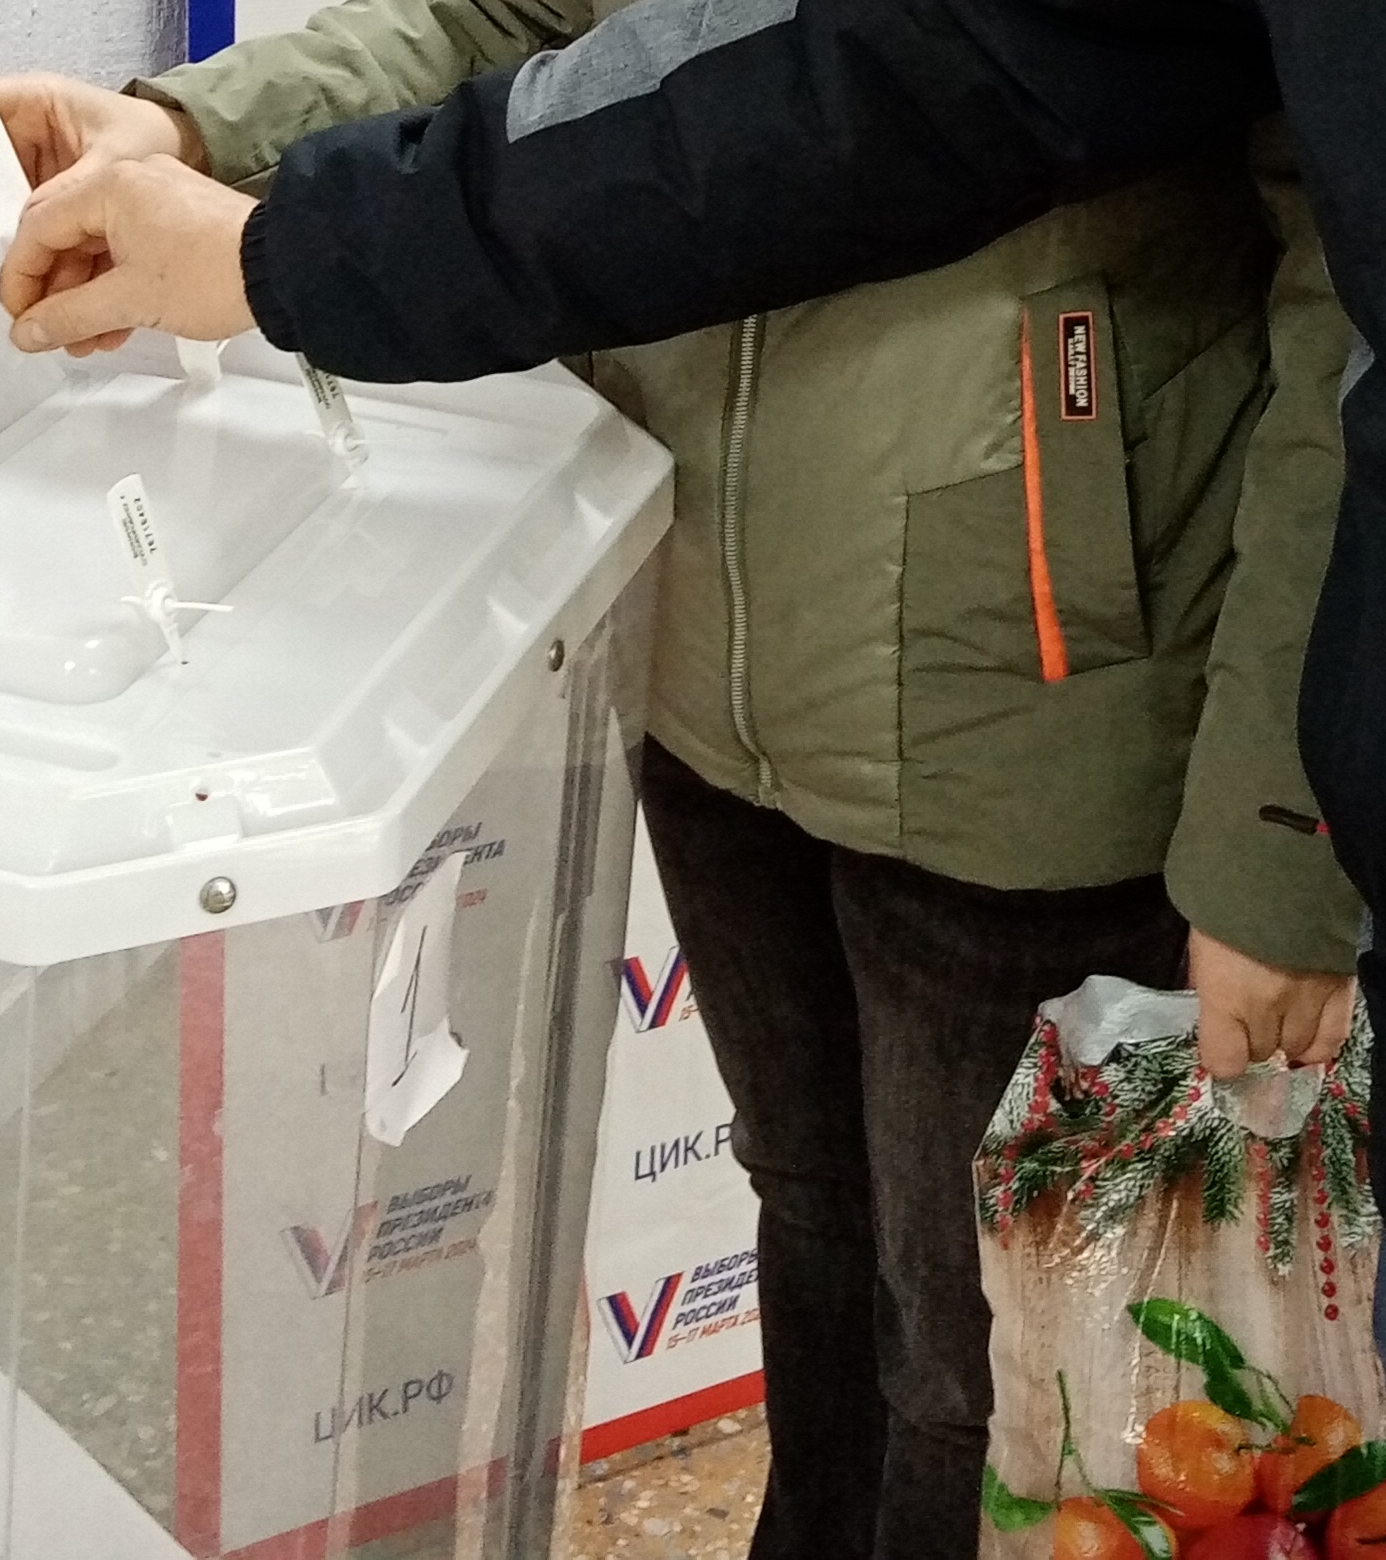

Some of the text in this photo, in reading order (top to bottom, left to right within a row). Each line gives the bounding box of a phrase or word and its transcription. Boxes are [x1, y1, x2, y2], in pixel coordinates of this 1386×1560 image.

[1073, 325, 1089, 408] NEW FASHION
[634, 1123, 733, 1183] ЦИК.Р
[671, 1294, 741, 1331] РОССИИ
[680, 1269, 760, 1307] ПРЕЗИДЕ
[699, 1313, 740, 1339] МАРТА
[740, 1307, 761, 1326] 202
[314, 1369, 456, 1444] ЦИК.РФ
